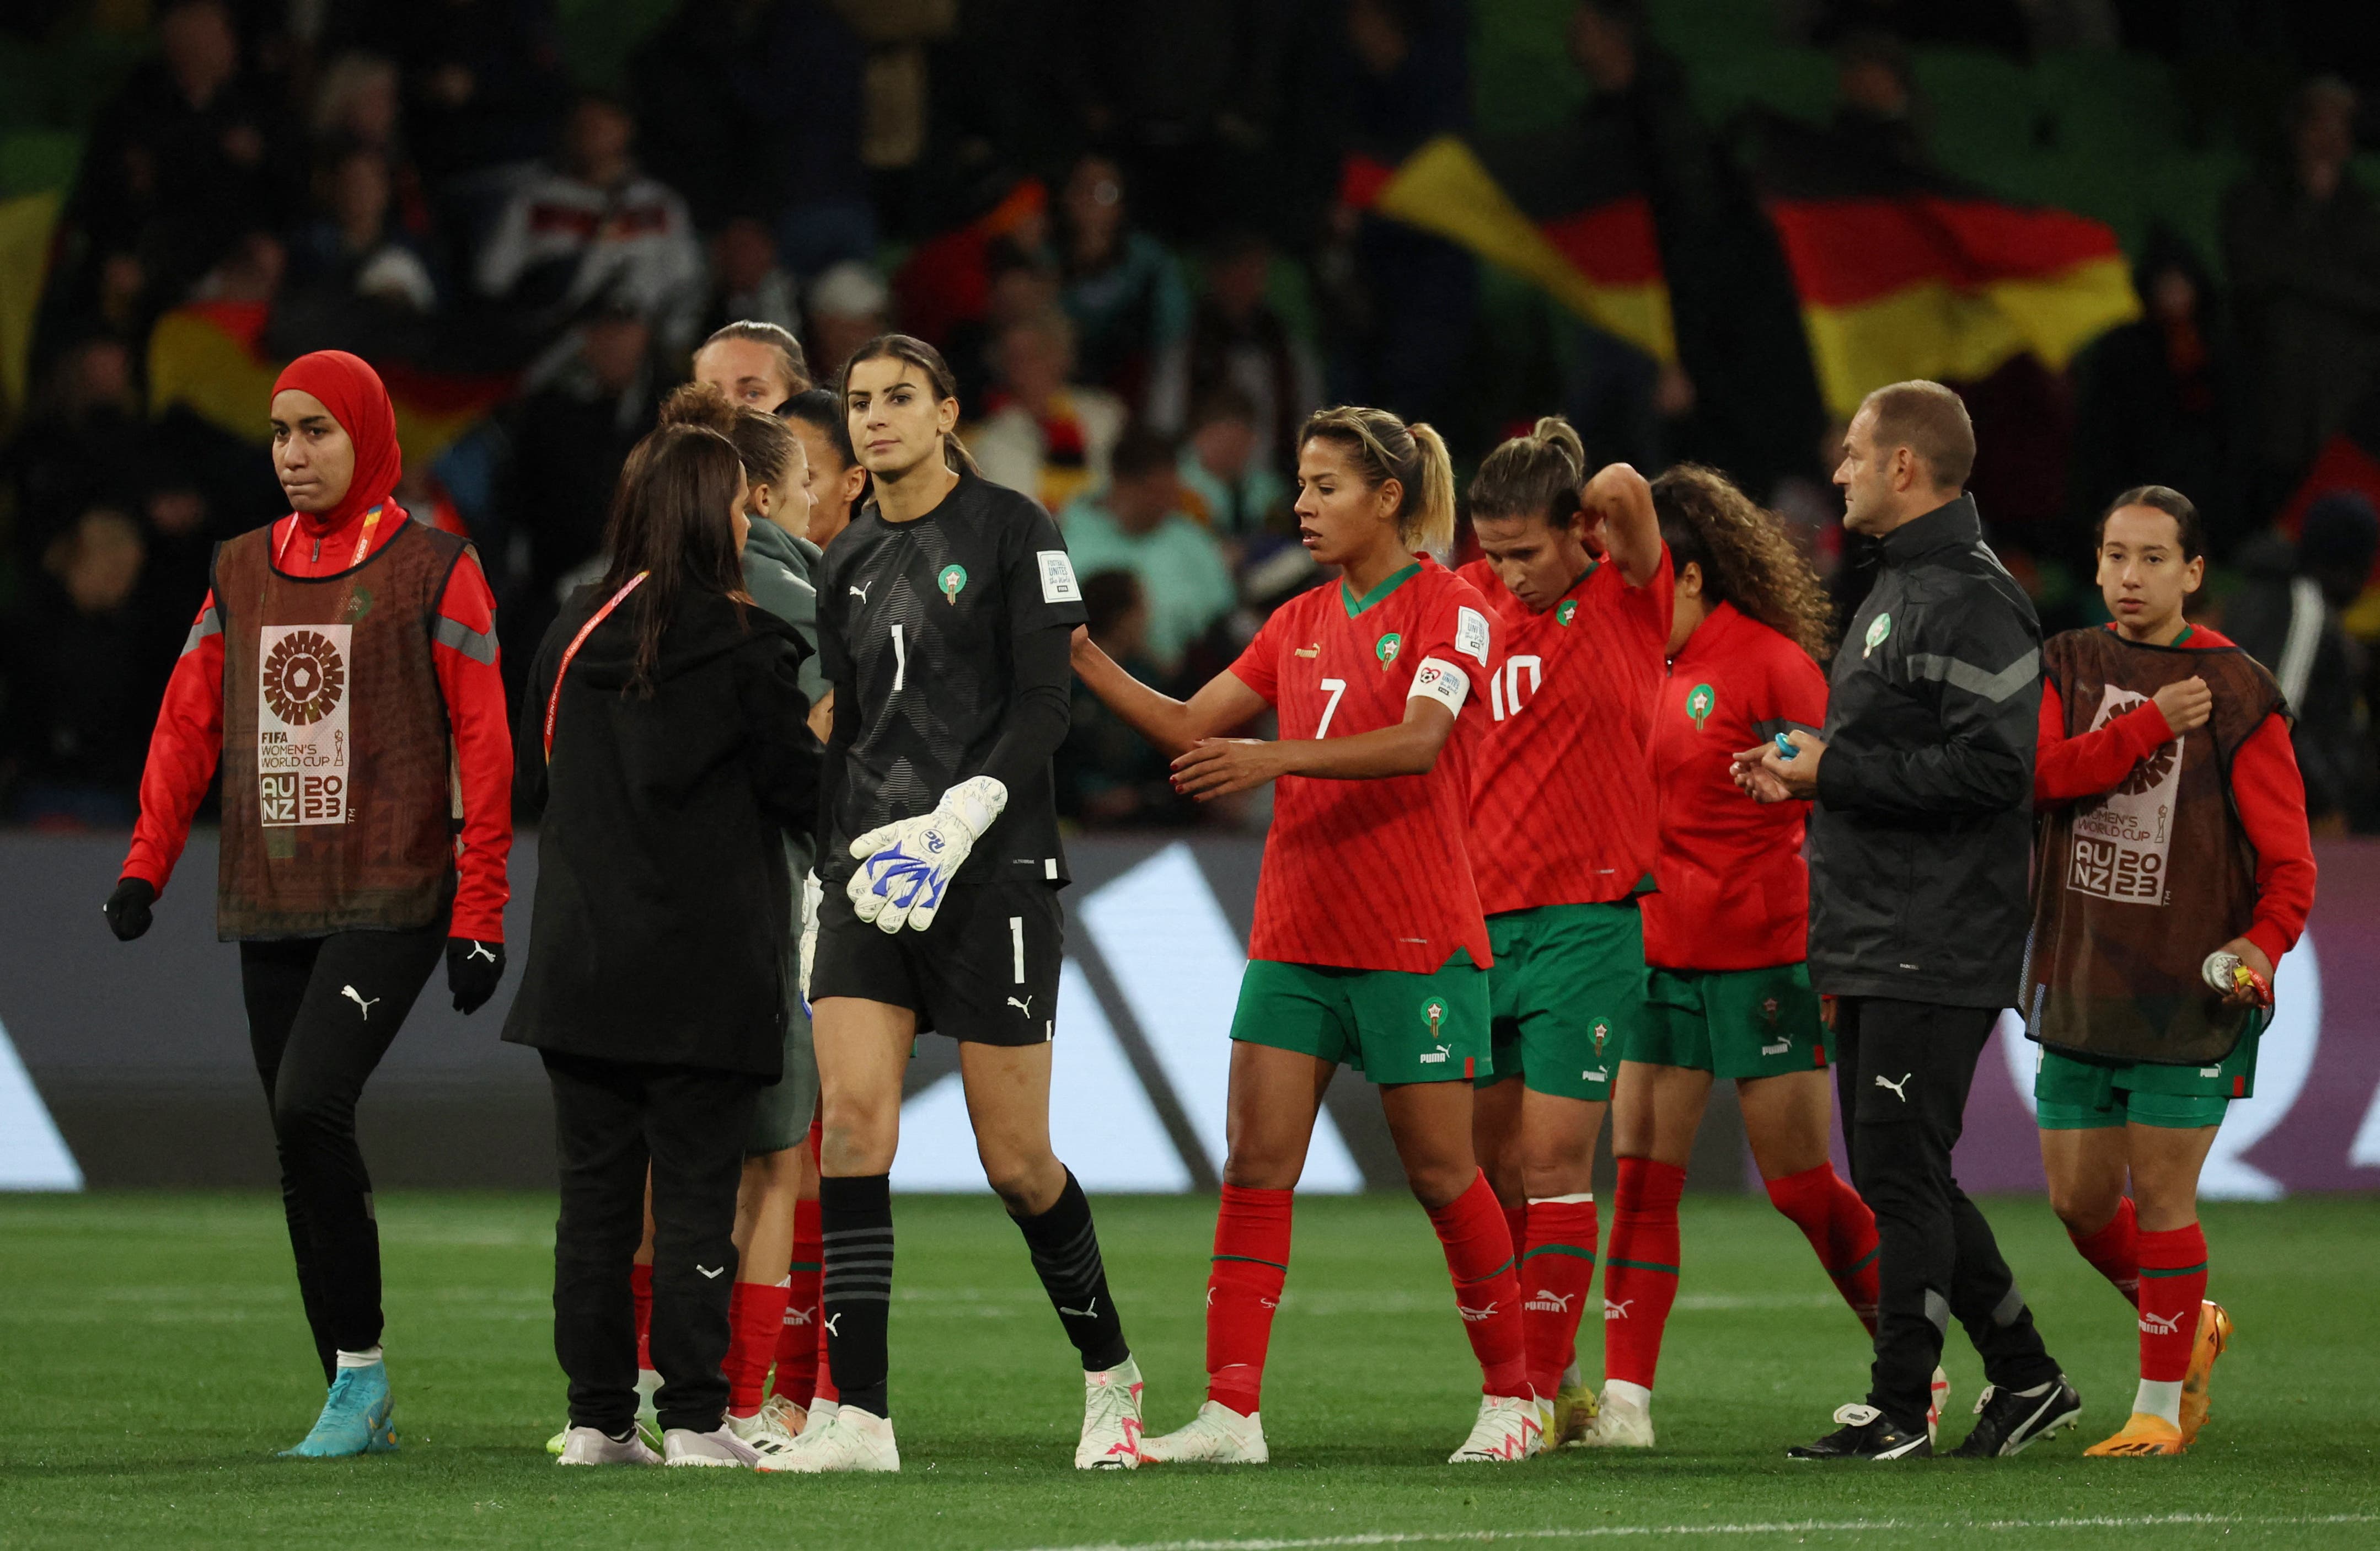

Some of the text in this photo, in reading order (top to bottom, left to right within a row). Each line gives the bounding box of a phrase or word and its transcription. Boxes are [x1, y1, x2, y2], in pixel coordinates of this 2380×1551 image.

[1049, 566, 1068, 576] UNITES
[891, 624, 904, 691] 1
[1491, 655, 1541, 721] 10
[1315, 678, 1346, 739] 7
[262, 732, 288, 744] FIFA
[262, 744, 317, 756] WOMEN'S
[262, 756, 330, 768] WORLD CUP
[262, 776, 295, 798] AU
[304, 776, 342, 796] 20
[263, 799, 296, 820] NZ
[305, 798, 341, 819] 23
[2092, 809, 2138, 828] OMEN'S
[2078, 818, 2151, 842] WORLD CUP
[2076, 840, 2113, 867] AU
[2119, 849, 2162, 874] 20
[2075, 863, 2109, 891] NZ
[2115, 872, 2158, 897] 23
[1010, 917, 1025, 984] 1
[1420, 1052, 1445, 1063] PUMA
[1525, 1301, 1560, 1313] PUMA
